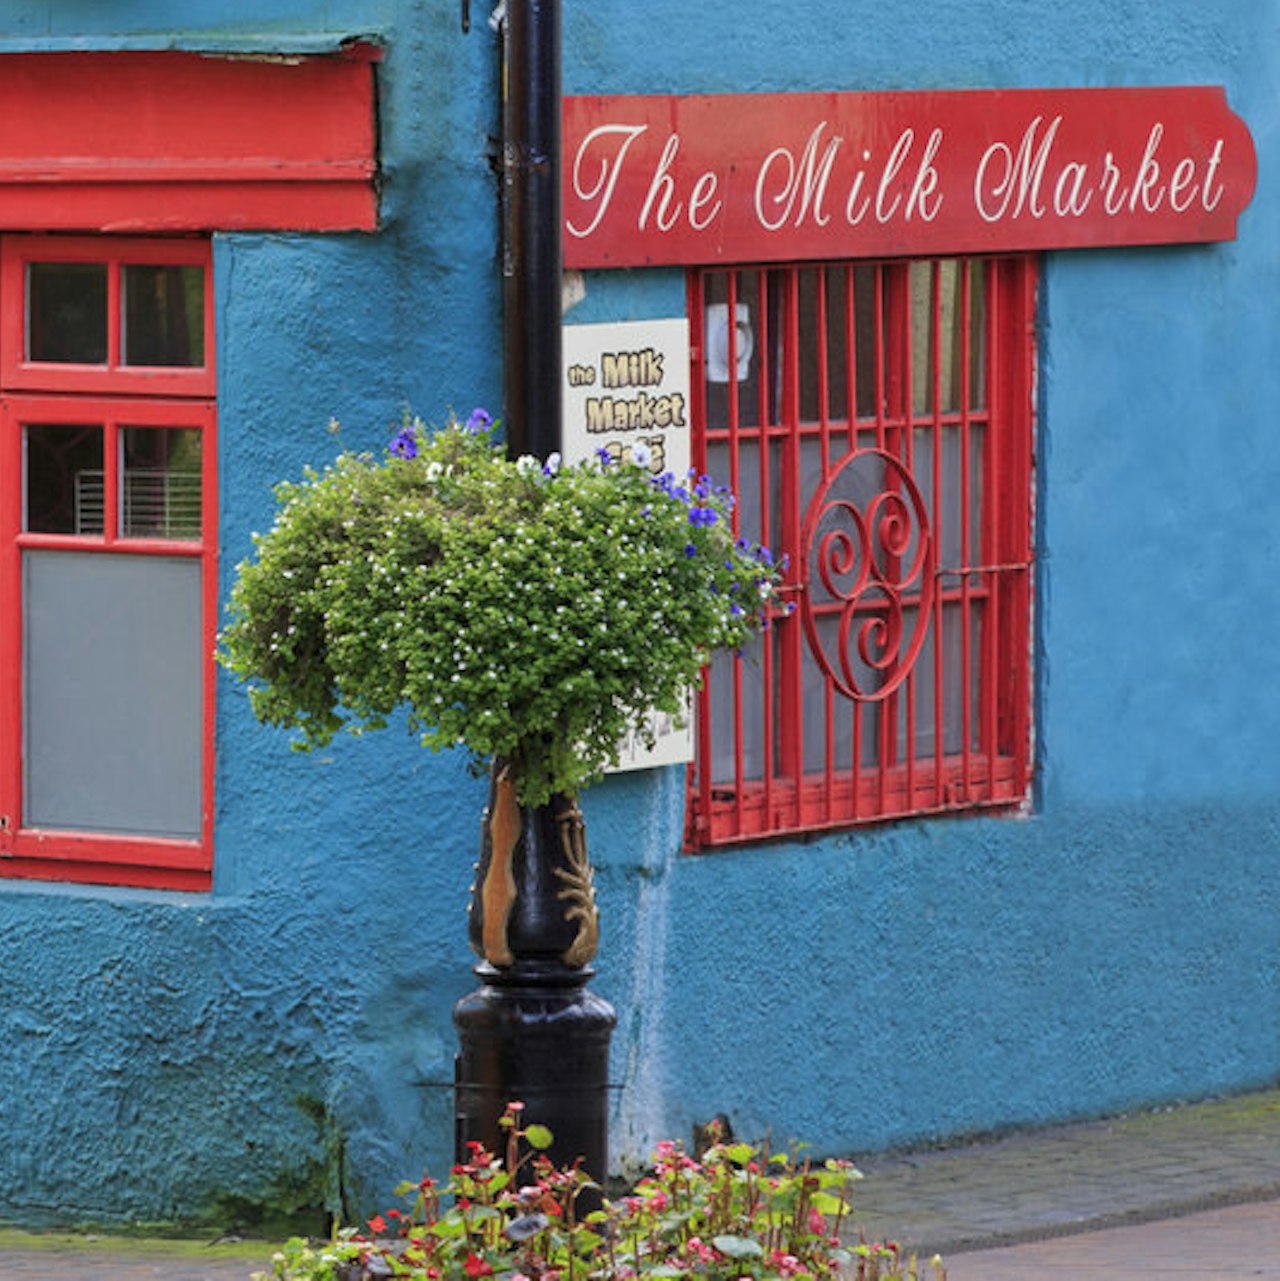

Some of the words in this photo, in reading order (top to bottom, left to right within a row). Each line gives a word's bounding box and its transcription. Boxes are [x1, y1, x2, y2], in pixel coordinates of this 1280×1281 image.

[566, 123, 721, 238] The
[755, 121, 943, 231] Milk
[974, 115, 1224, 224] Market
[568, 363, 596, 388] the
[600, 347, 665, 391] Milk
[586, 392, 687, 435] Market
